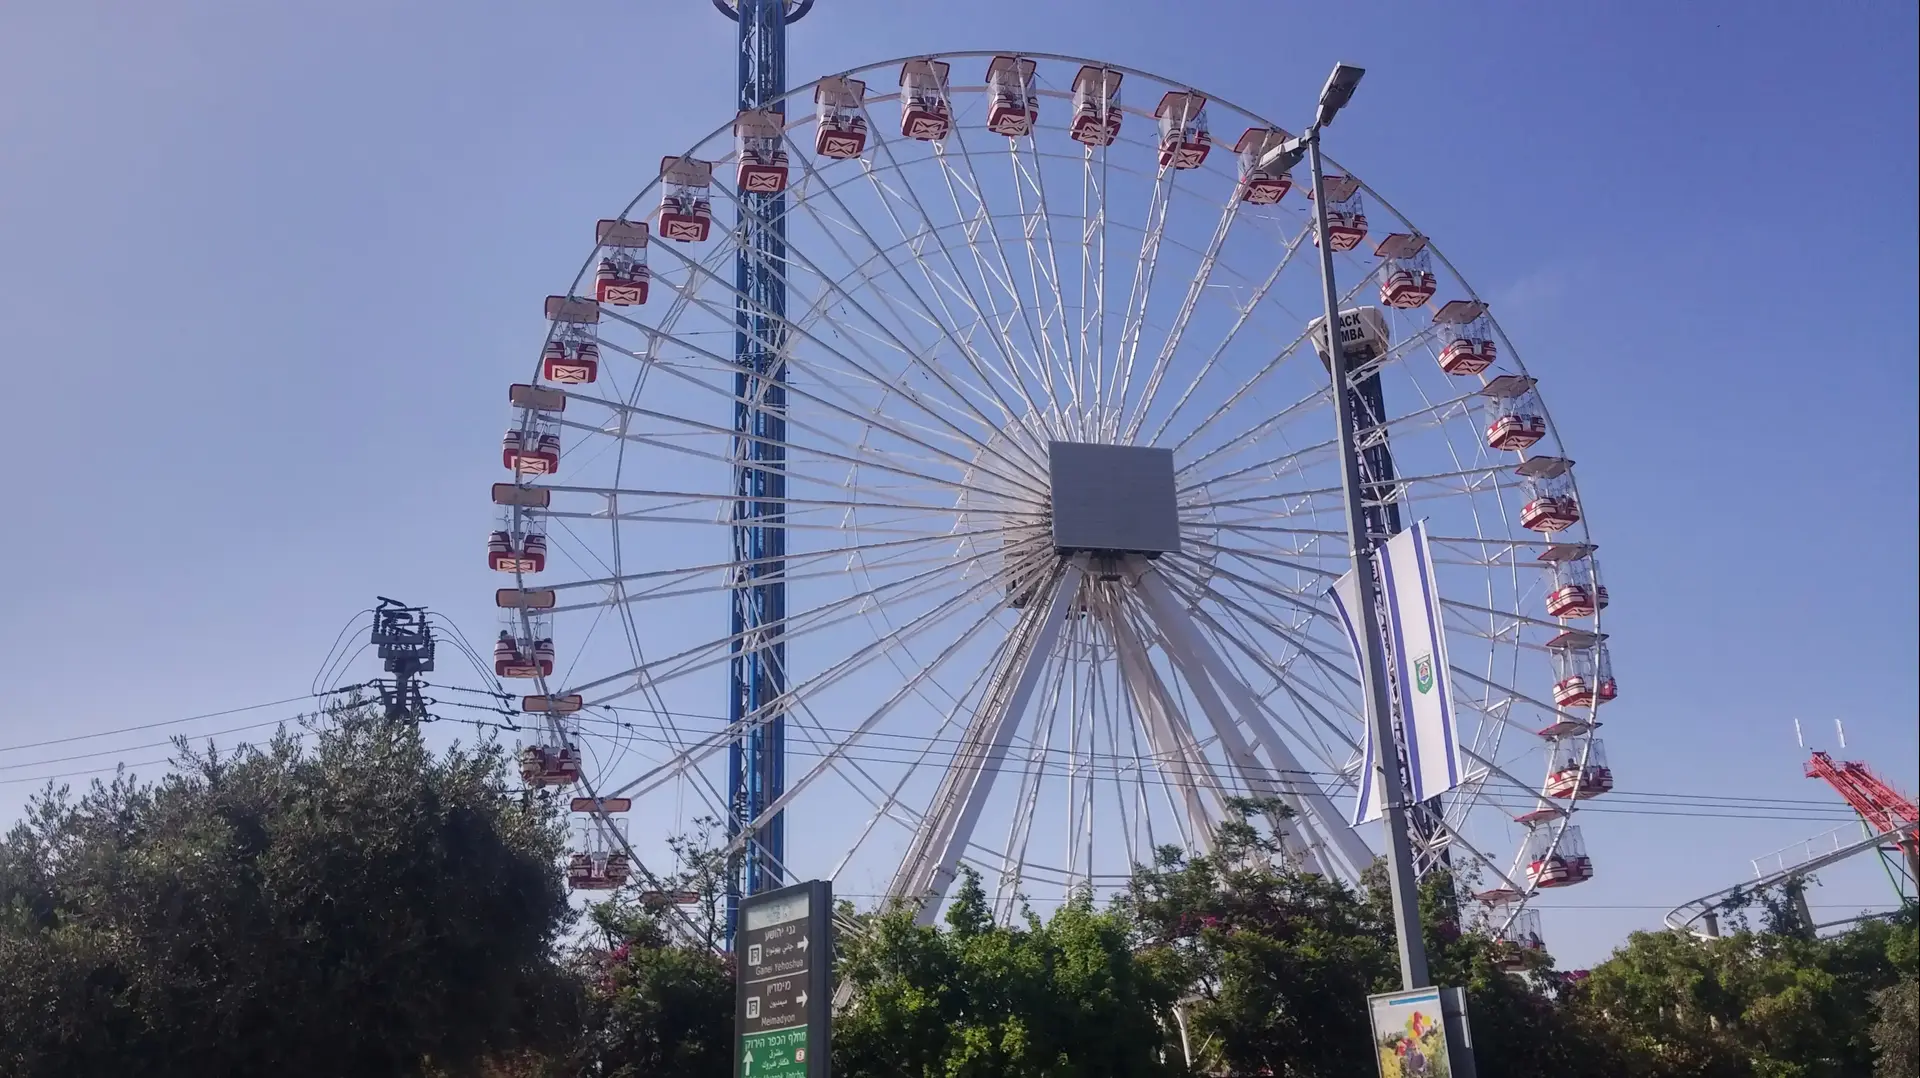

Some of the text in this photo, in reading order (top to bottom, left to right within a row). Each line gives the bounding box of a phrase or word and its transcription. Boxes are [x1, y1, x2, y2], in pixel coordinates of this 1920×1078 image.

[764, 925, 796, 942] גני יהושע
[755, 959, 803, 976] Ganei Yehoshua
[766, 980, 791, 996] מימדיון
[745, 1031, 806, 1052] מחלף הכפר הירוק
